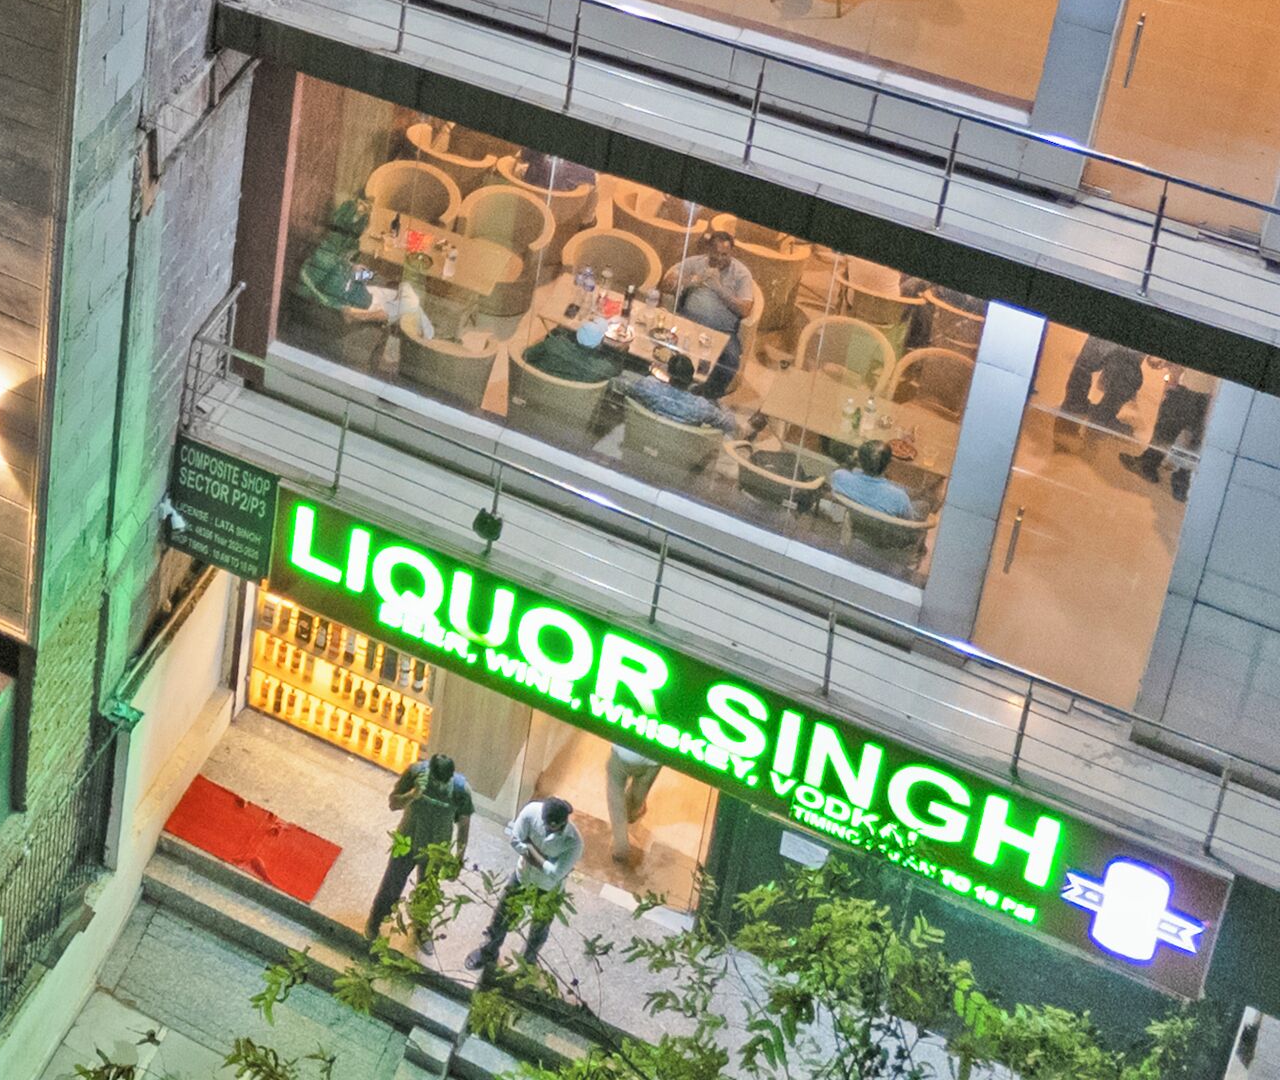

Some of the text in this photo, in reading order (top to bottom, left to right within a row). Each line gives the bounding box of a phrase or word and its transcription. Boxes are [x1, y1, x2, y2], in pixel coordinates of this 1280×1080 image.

[179, 467, 268, 518] SECTOR P2/P3
[180, 445, 271, 496] COMPOSITE SHOP
[214, 517, 235, 533] LATA
[291, 504, 1062, 890] LIQUOR SINGH
[485, 647, 582, 709] WINE,
[590, 693, 758, 786] WHISKEY,
[793, 805, 861, 845] TIMING
[941, 868, 972, 894] TO
[974, 885, 999, 907] 10
[1001, 897, 1037, 923] PM
